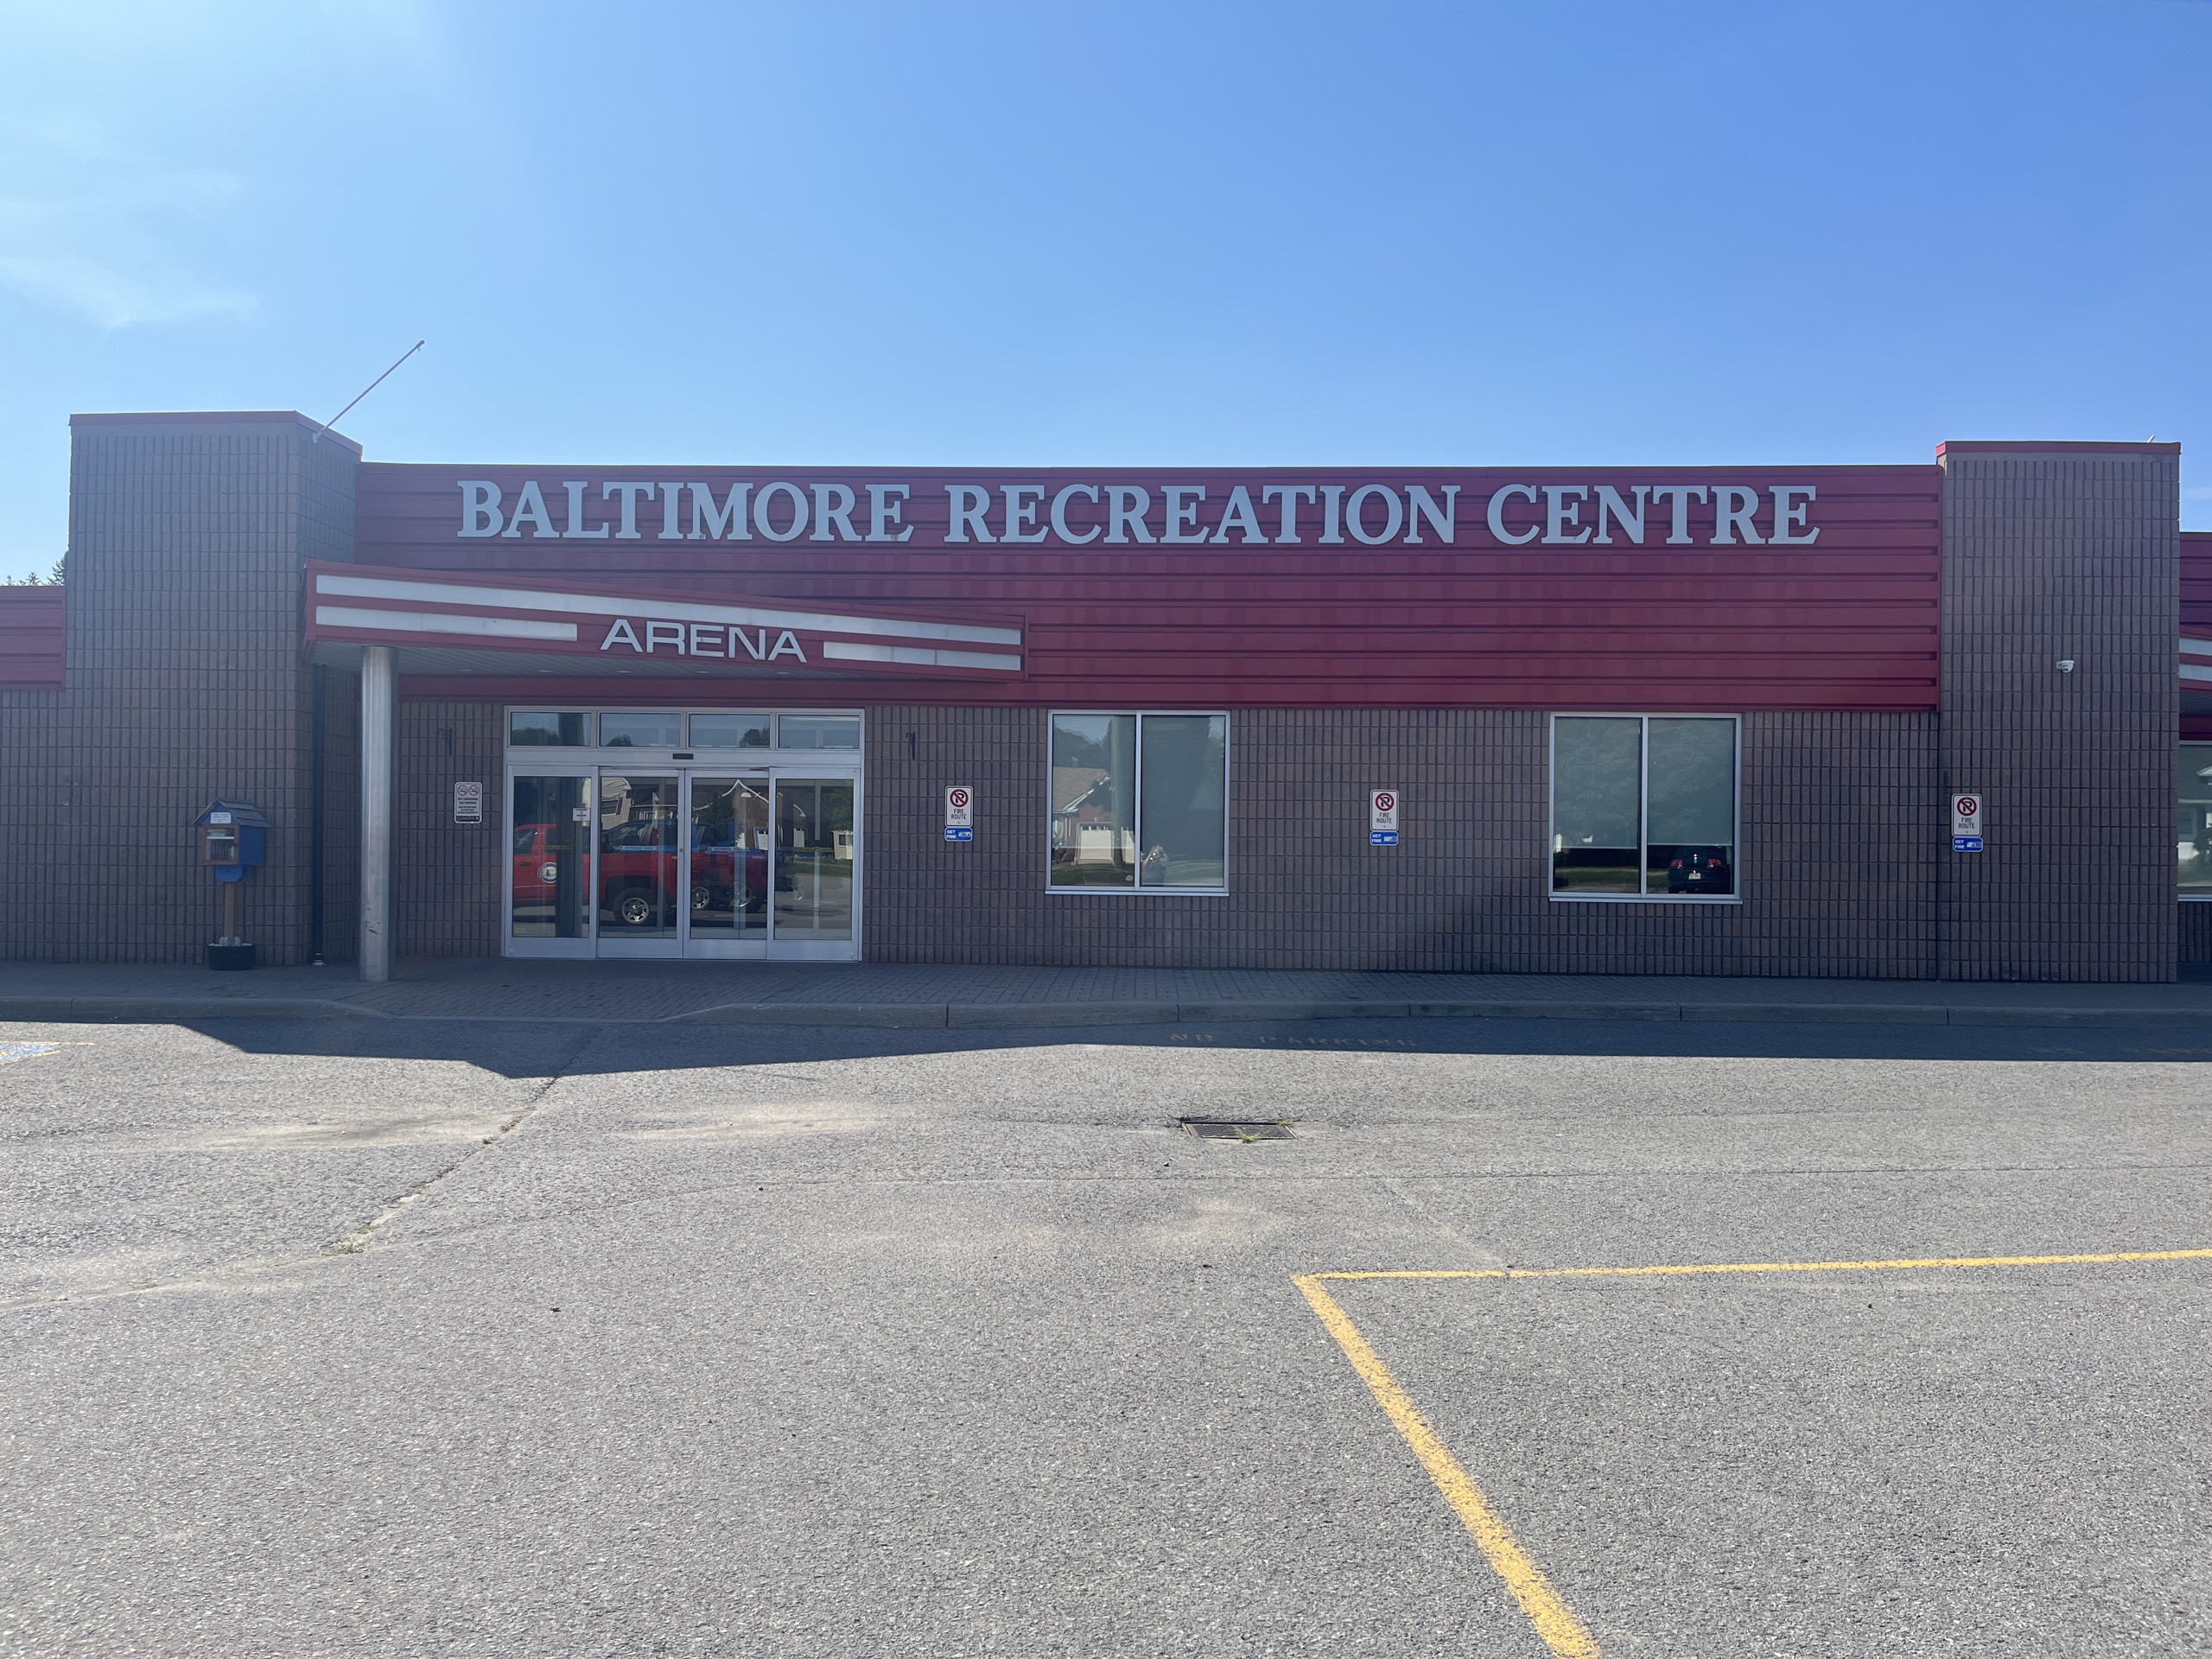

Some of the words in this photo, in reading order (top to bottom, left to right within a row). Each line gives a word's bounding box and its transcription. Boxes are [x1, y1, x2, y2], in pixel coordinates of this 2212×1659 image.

[457, 480, 914, 542] BALTIMORE
[944, 484, 1461, 544] RECREATION
[1487, 484, 1821, 545] CENTRE
[600, 618, 808, 663] ARENA
